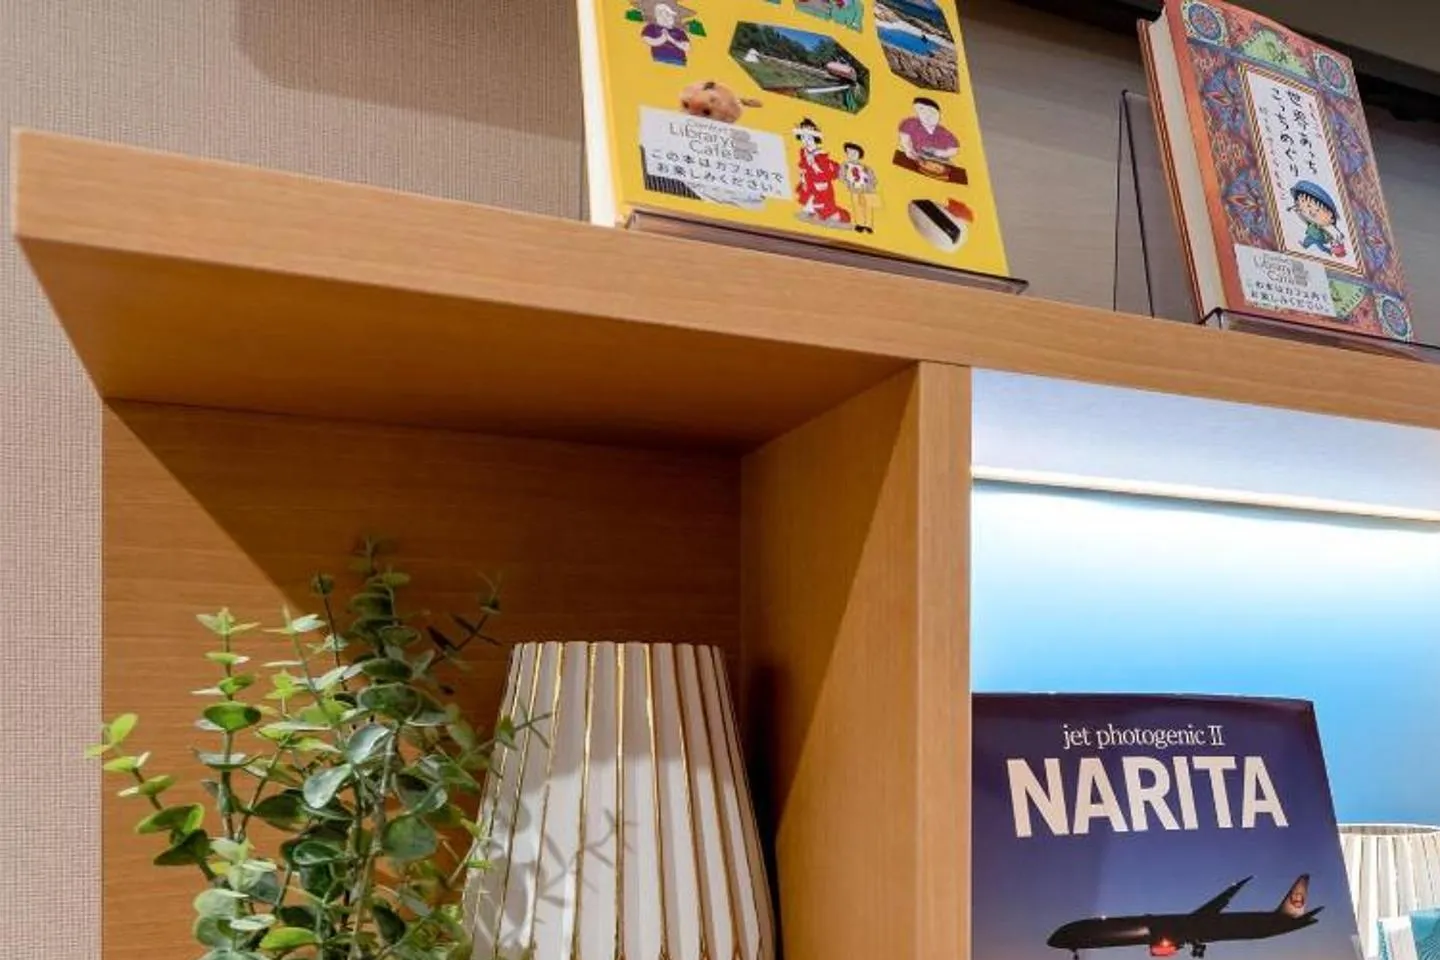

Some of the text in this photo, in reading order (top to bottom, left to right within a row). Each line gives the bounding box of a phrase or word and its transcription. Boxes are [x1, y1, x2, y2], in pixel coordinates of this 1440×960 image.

[1062, 725, 1091, 750] jet
[1096, 724, 1206, 750] photogenic
[1006, 755, 1290, 838] NARITA
